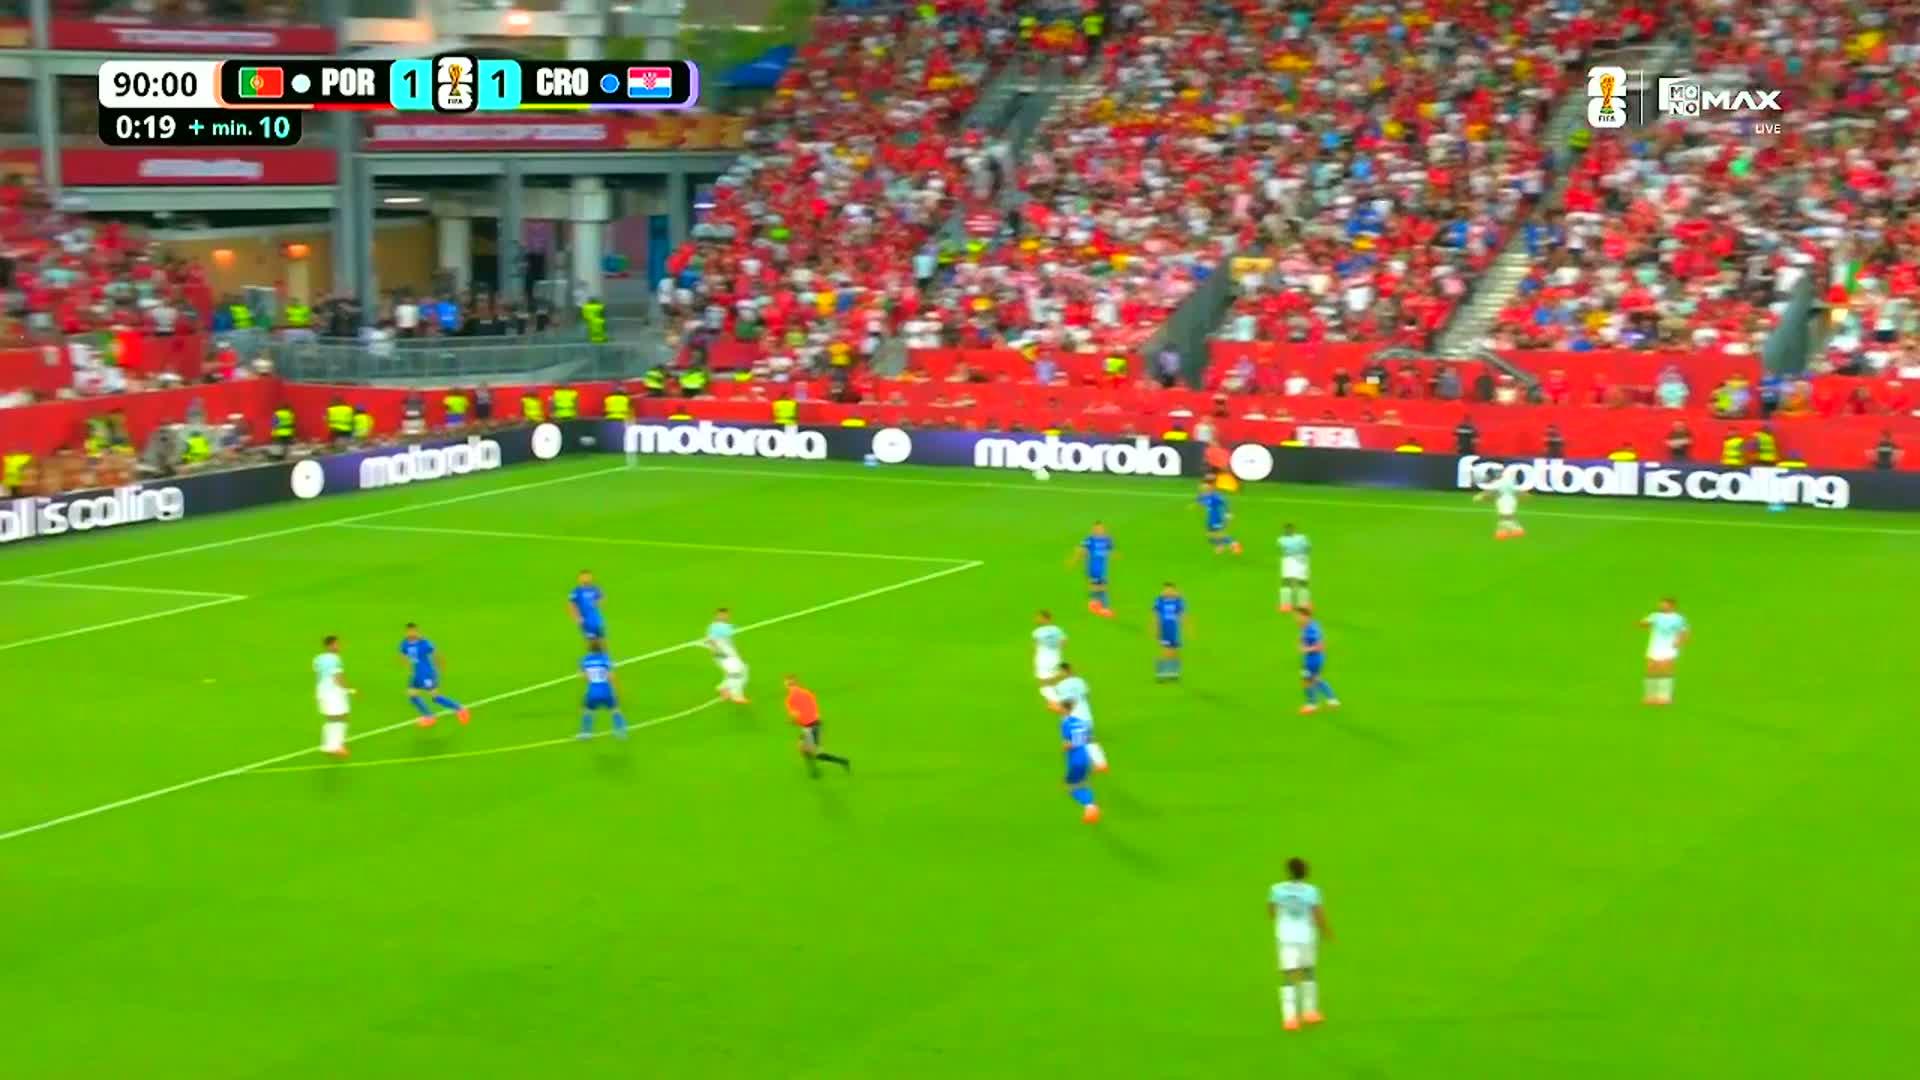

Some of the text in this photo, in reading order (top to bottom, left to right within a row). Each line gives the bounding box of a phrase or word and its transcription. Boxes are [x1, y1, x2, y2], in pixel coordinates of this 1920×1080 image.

[624, 420, 827, 459] motorola
[974, 434, 1181, 475] motorola
[1457, 455, 1849, 509] football is calling
